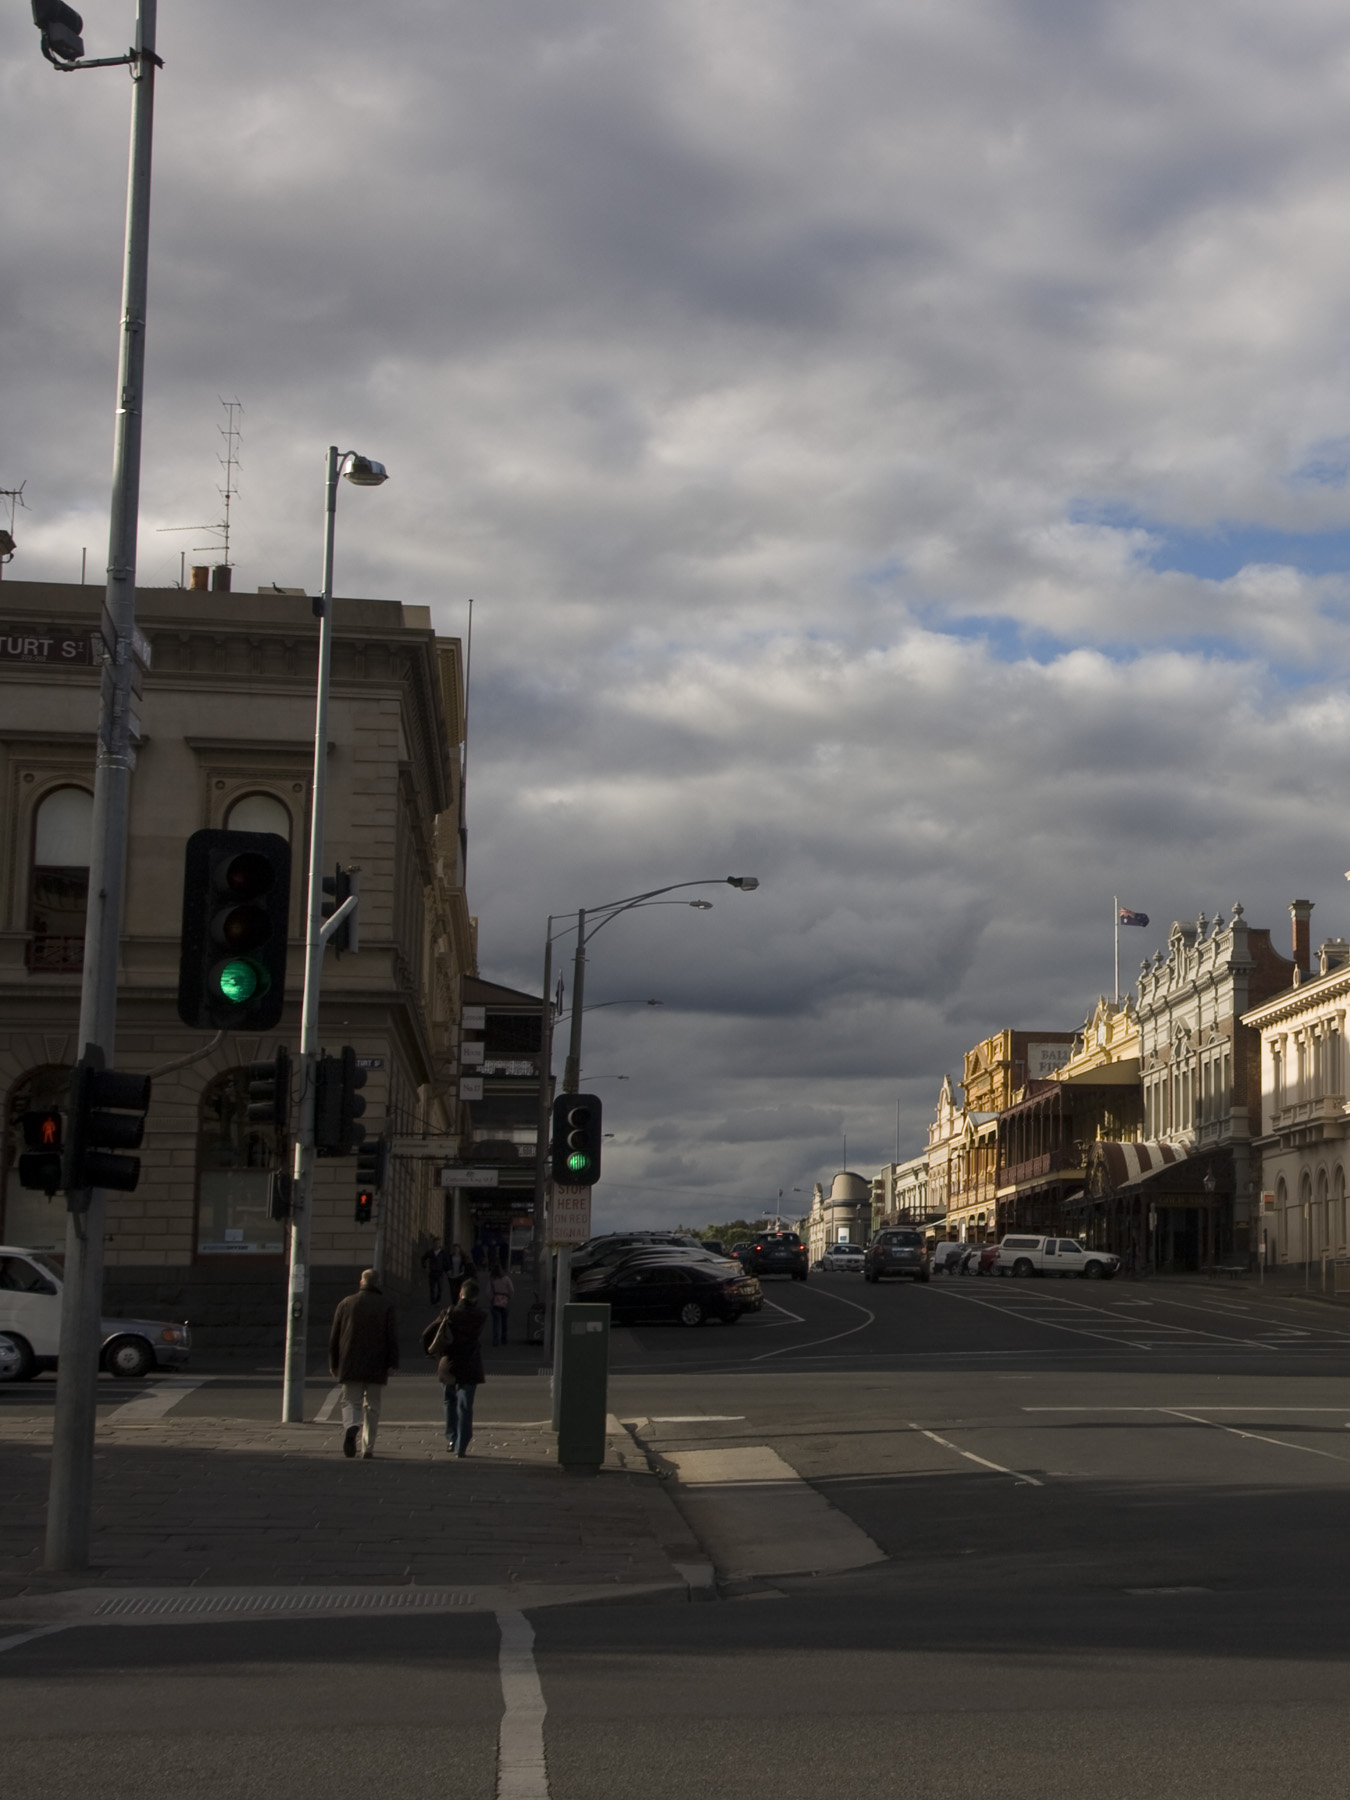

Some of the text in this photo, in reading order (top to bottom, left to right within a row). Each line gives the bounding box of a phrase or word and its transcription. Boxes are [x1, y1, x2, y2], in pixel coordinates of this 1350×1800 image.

[558, 1185, 586, 1194] STOP
[557, 1198, 587, 1210] HERE
[554, 1214, 587, 1224] ON RED
[554, 1228, 587, 1238] SIGNAL
